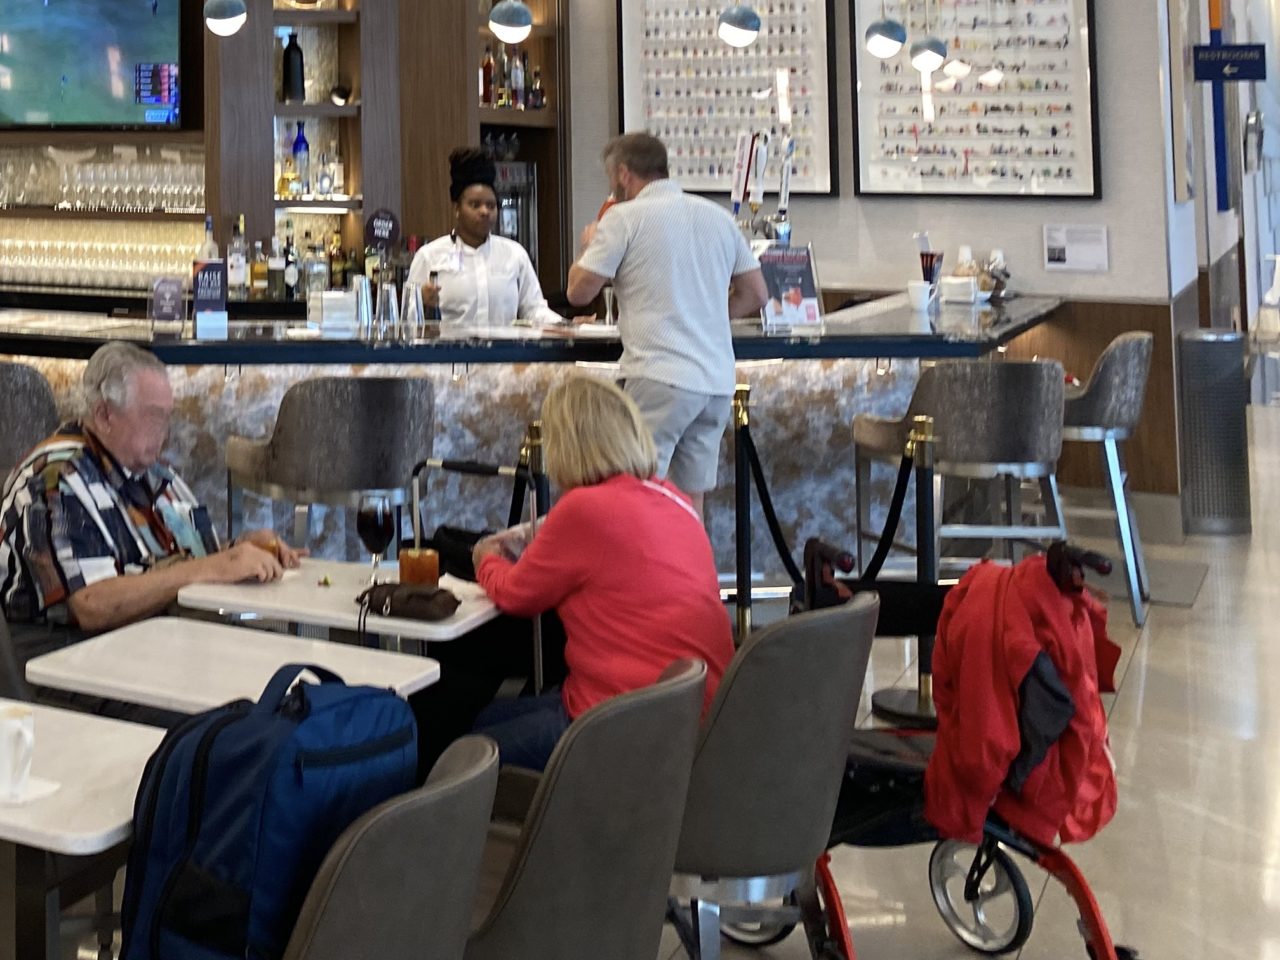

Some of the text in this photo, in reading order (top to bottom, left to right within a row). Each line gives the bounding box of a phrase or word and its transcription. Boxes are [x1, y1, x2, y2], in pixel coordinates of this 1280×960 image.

[1199, 50, 1260, 60] RESTROOMS
[373, 218, 393, 230] ORDER
[374, 228, 389, 239] HERE
